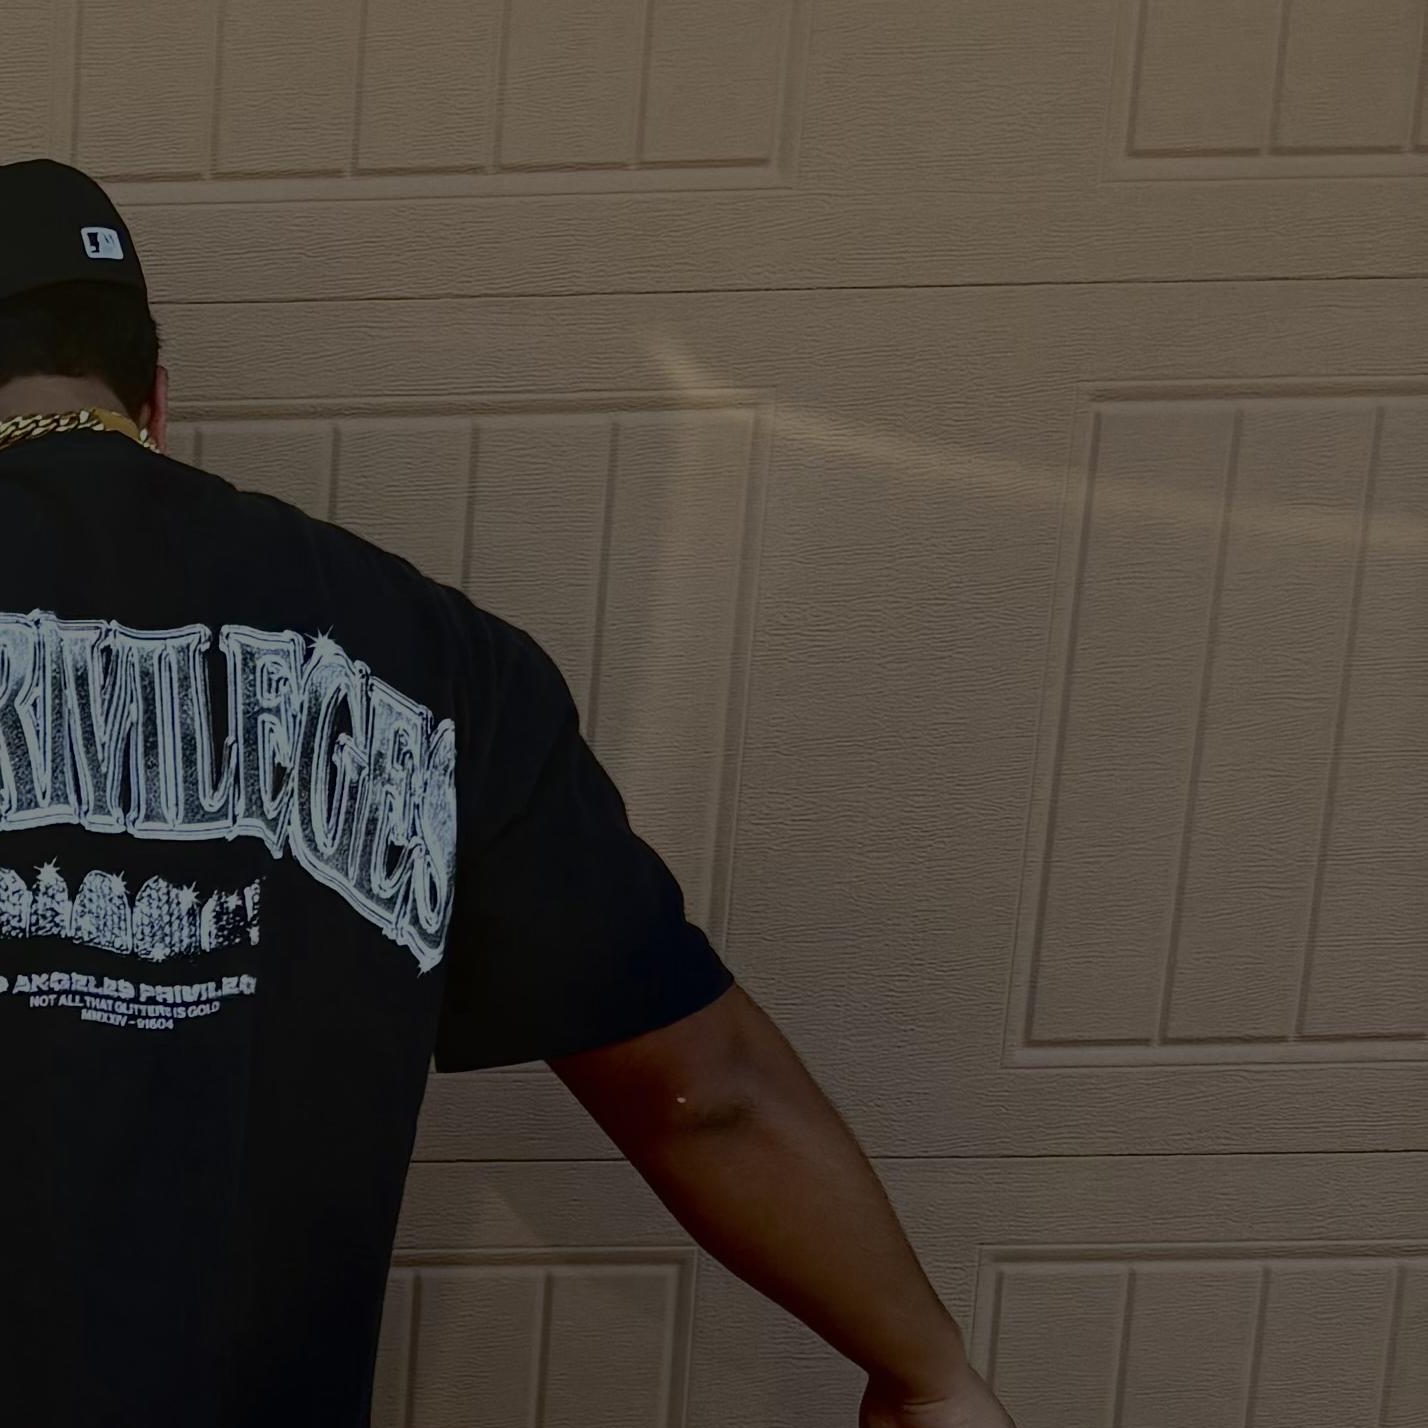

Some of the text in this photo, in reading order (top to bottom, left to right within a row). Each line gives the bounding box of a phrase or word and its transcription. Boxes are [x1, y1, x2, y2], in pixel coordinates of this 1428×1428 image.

[12, 971, 135, 1001] ANGELES
[29, 994, 58, 1008] NOT
[58, 994, 85, 1007] ALL
[84, 995, 114, 1012] THAT
[173, 1006, 186, 1019] IS
[186, 1001, 221, 1018] GOLD
